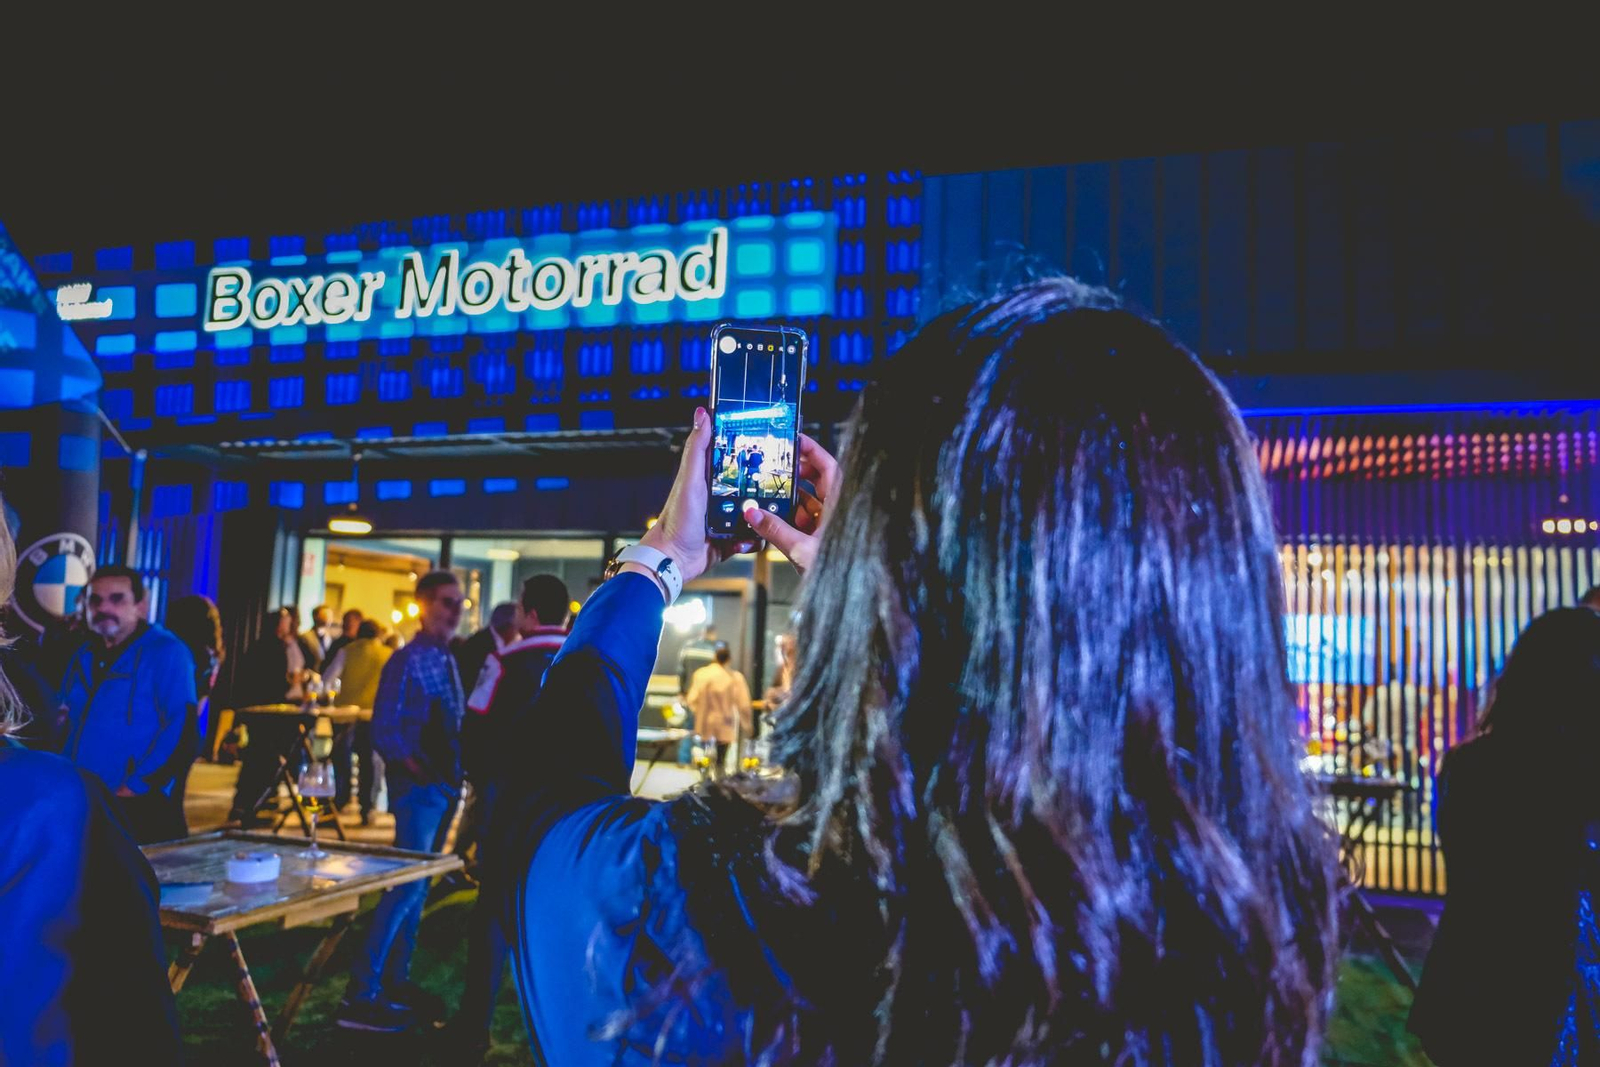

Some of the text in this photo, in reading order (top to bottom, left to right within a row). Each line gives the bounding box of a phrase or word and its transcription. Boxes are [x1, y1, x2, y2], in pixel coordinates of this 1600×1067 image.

[204, 226, 727, 331] Boxer Motorrad
[29, 539, 95, 568] BMW
